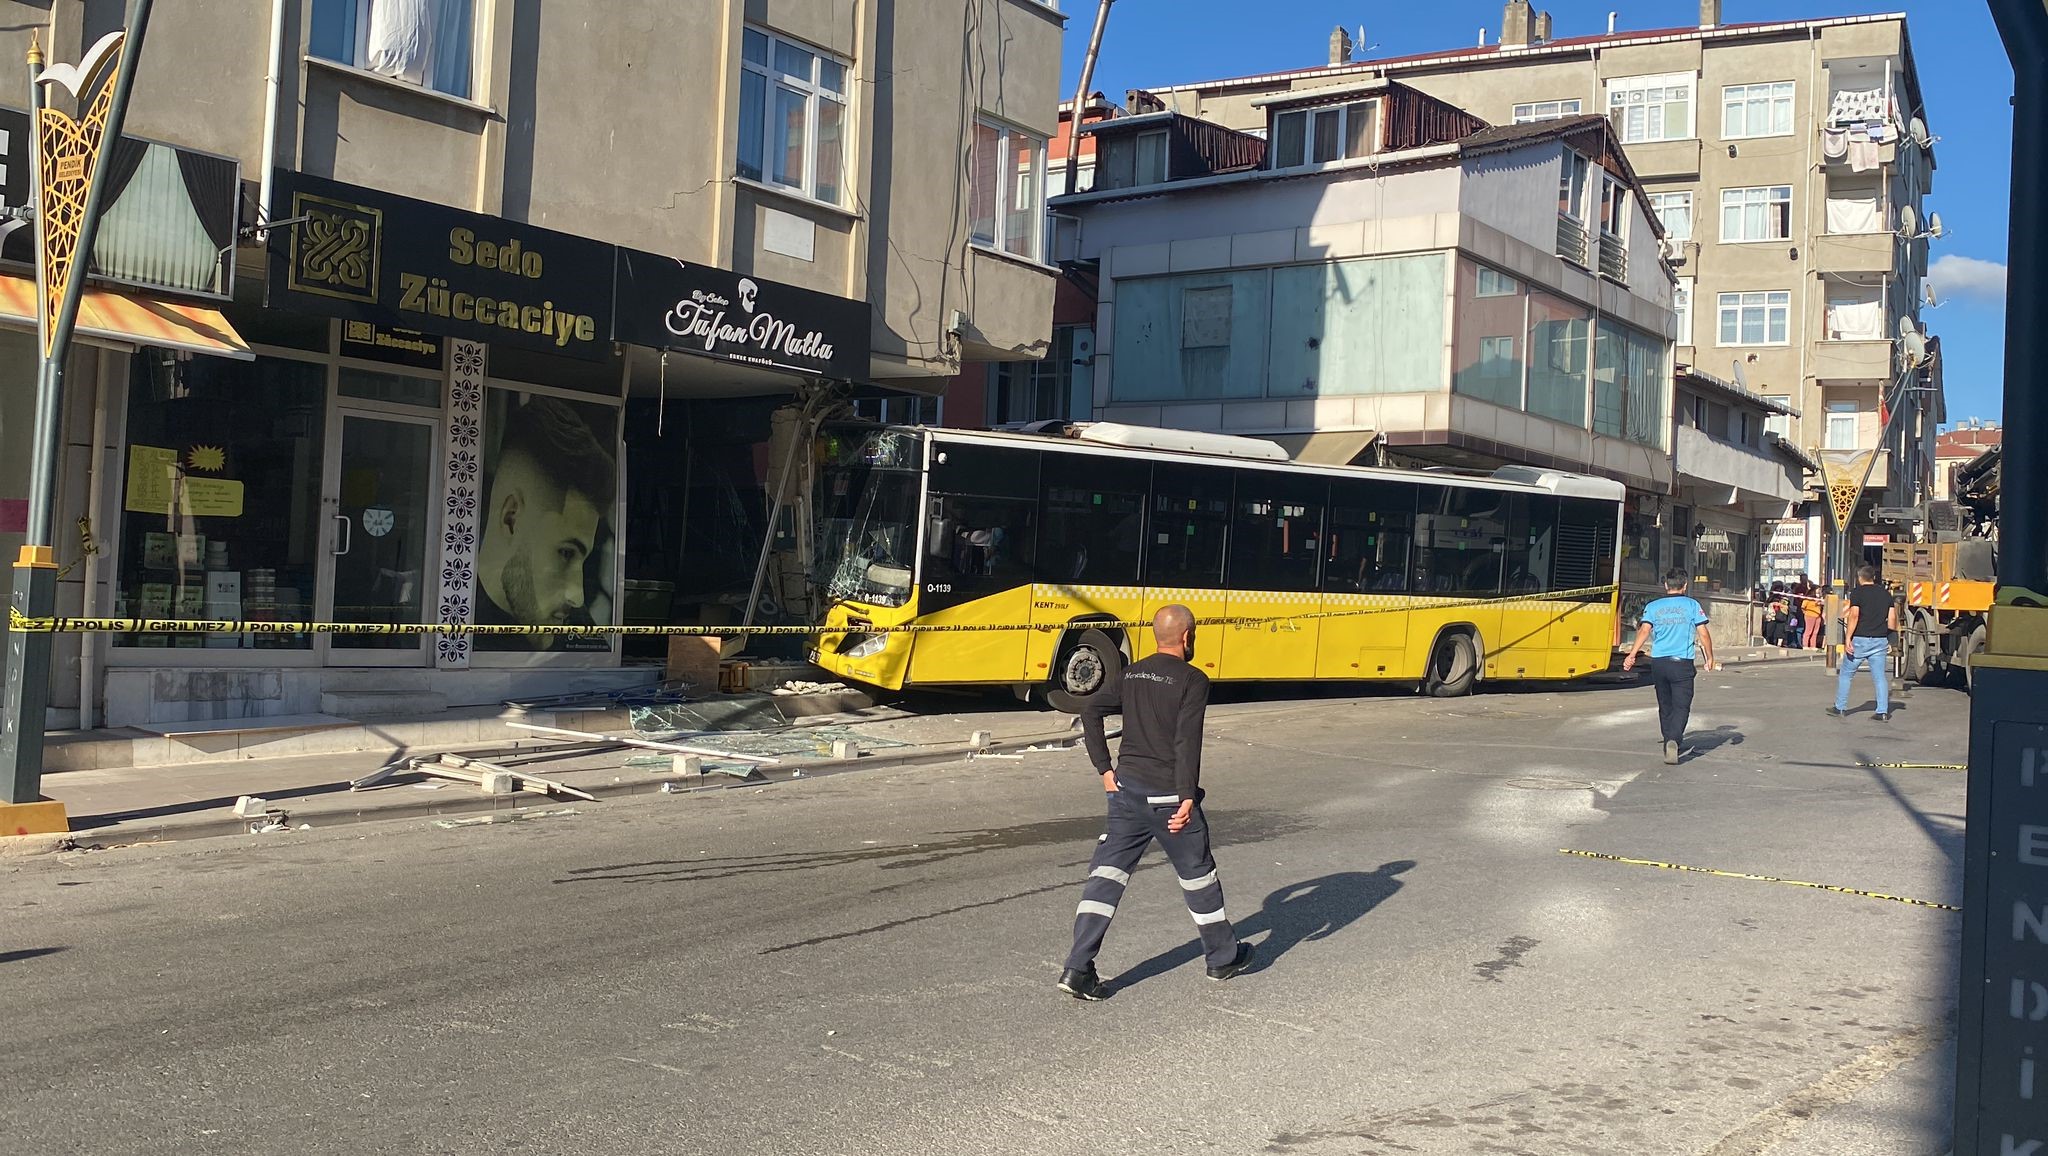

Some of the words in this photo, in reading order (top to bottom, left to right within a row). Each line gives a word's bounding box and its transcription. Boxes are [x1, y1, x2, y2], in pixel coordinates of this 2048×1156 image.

[449, 226, 543, 279] Sedo
[400, 272, 596, 347] Züccaciye
[665, 299, 748, 351] Tufan
[750, 312, 833, 360] Mutlu
[927, 583, 952, 593] O-1139
[1034, 601, 1054, 609] KENT
